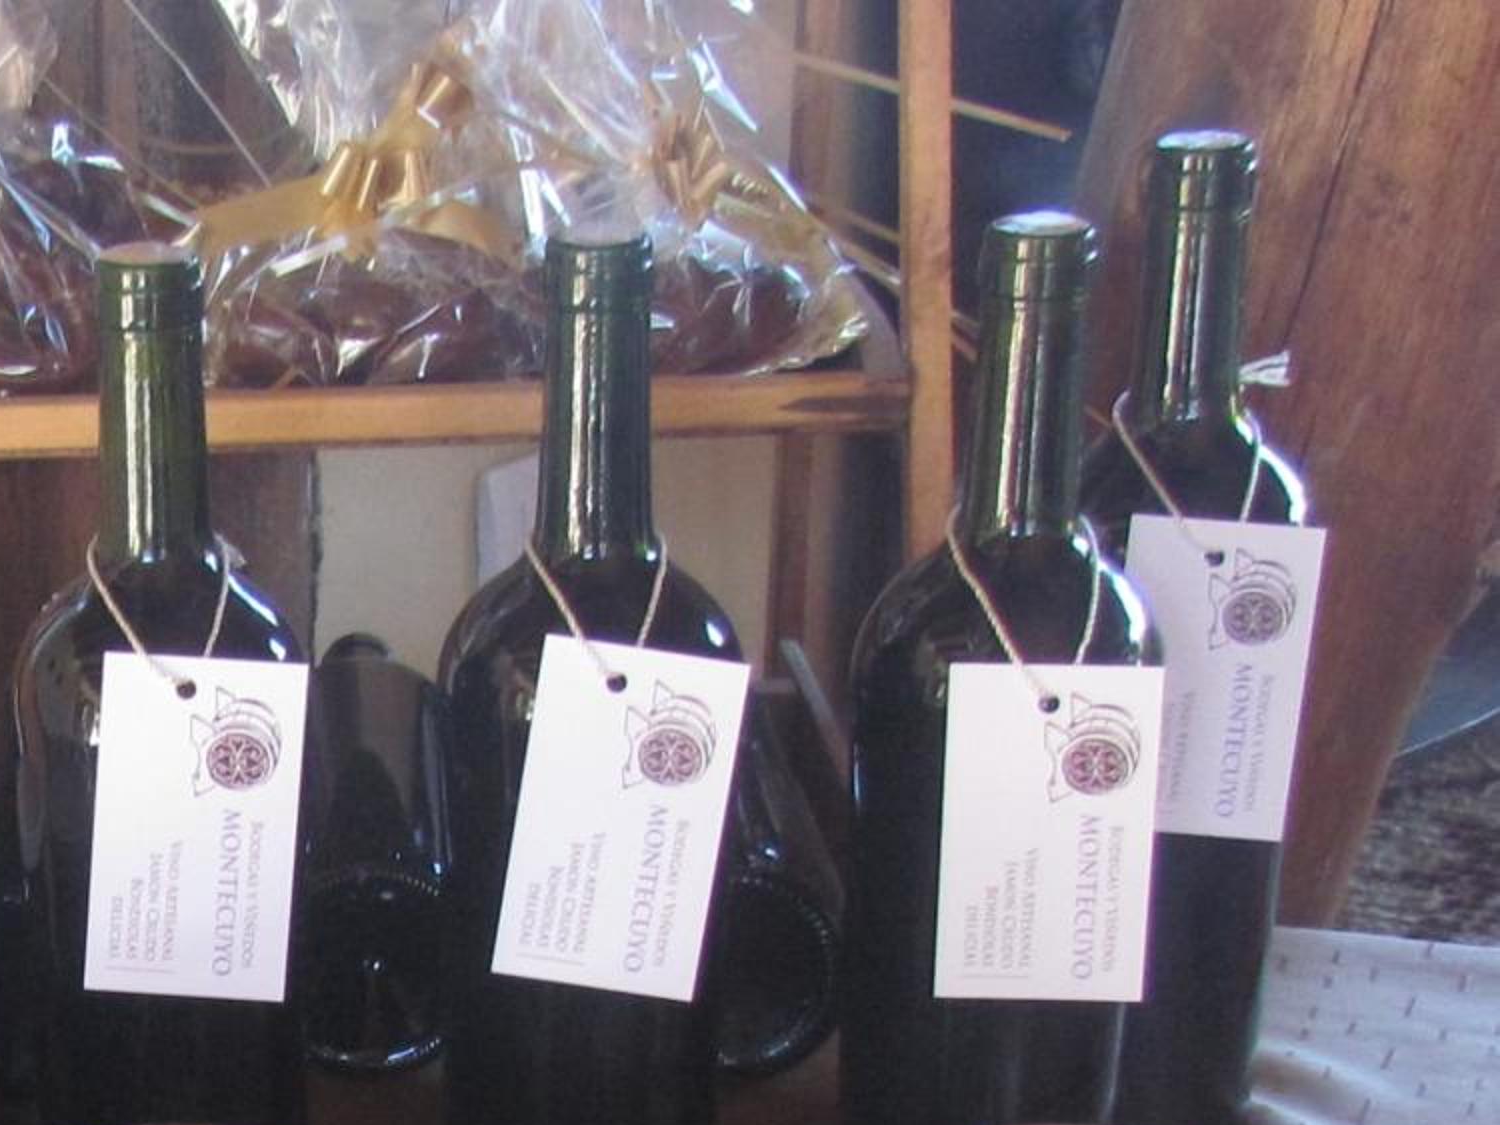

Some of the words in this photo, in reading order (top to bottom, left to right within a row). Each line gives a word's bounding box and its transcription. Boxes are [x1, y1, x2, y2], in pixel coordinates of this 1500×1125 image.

[1213, 663, 1254, 818] MONTECUYO
[211, 807, 243, 978] MONTECUYO
[623, 803, 670, 974] MONTECUYO
[1070, 815, 1102, 981] MONTECUYO
